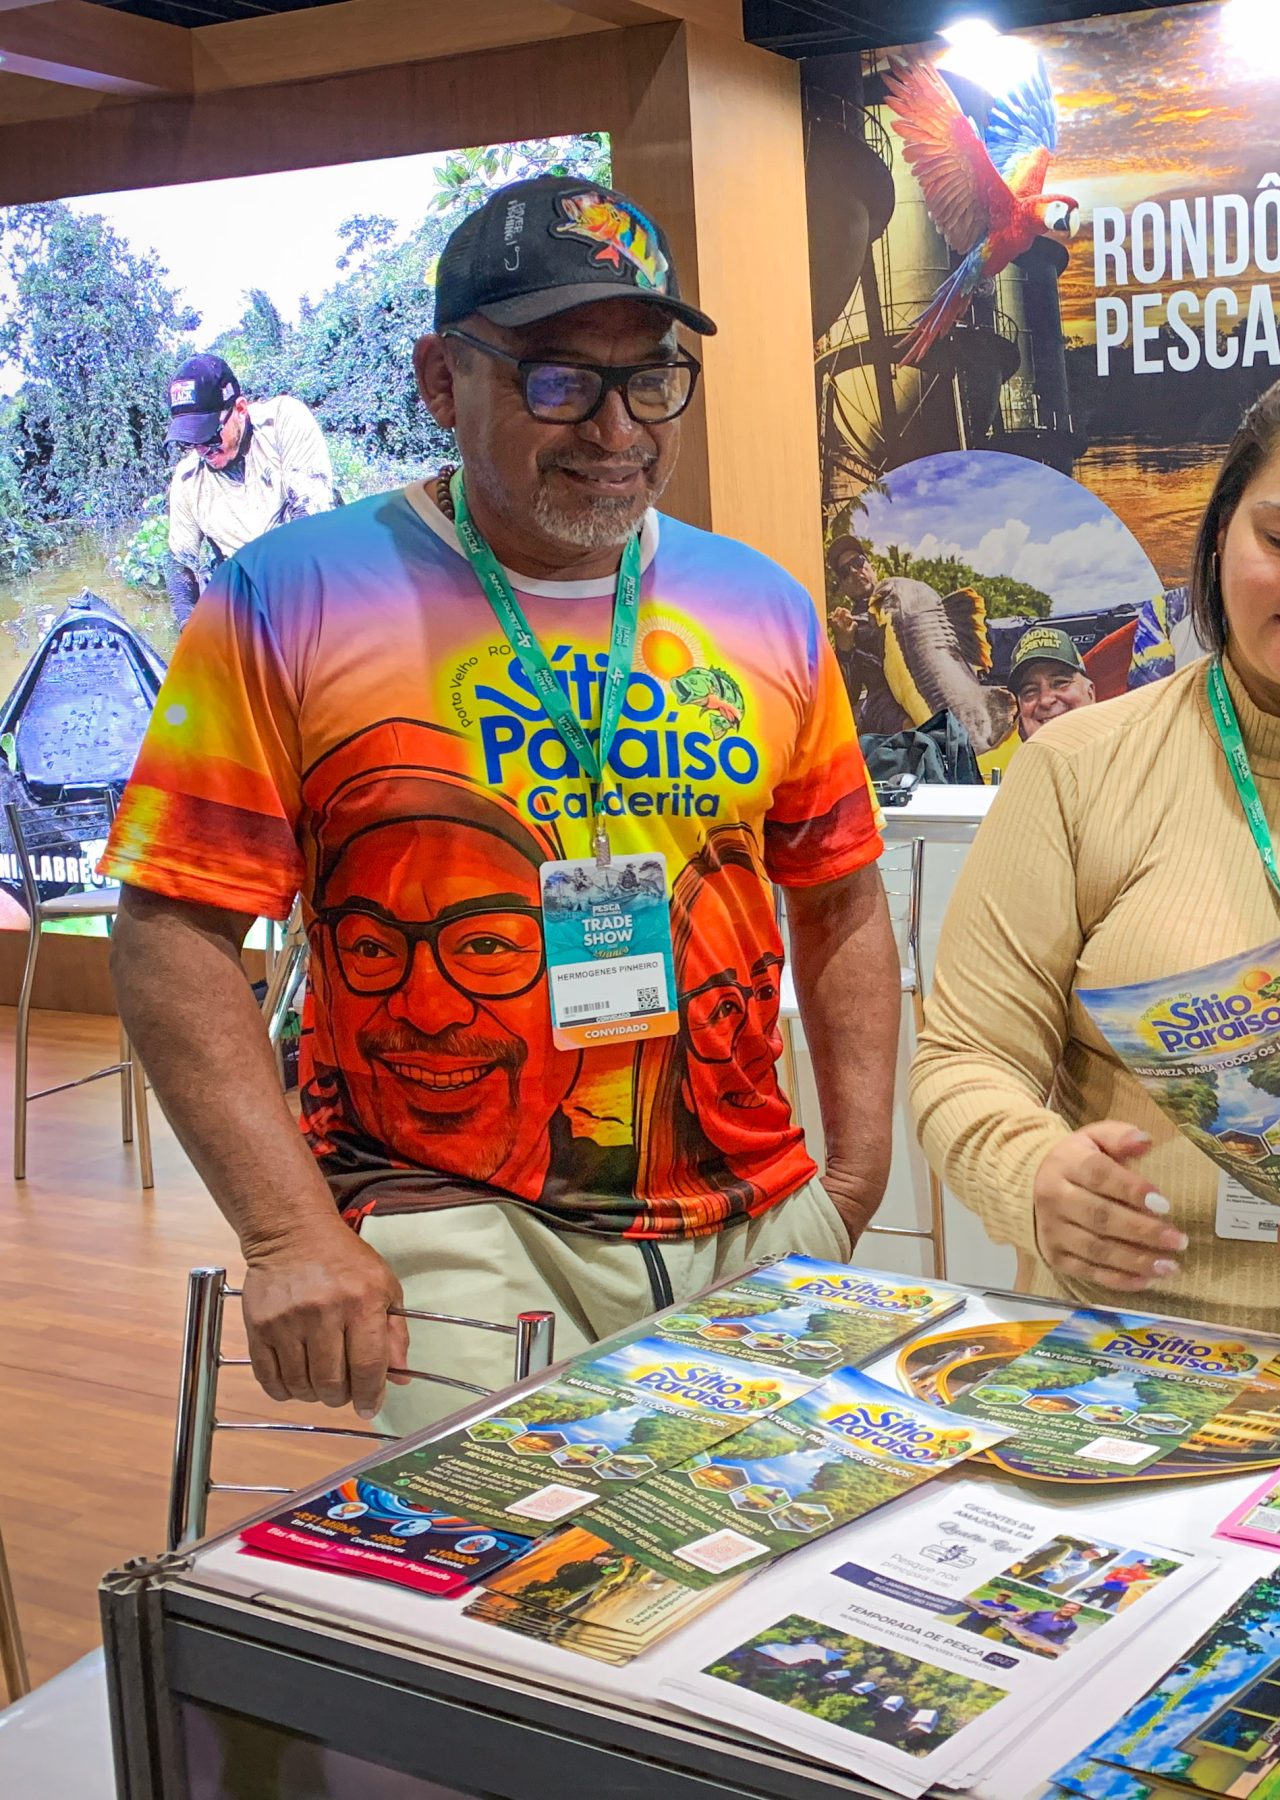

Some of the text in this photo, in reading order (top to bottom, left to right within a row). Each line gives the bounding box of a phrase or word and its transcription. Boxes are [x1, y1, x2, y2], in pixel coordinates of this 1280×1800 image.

[1097, 284, 1280, 376] PESCA
[460, 520, 481, 554] PESCA
[626, 575, 636, 607] PESCA
[450, 645, 511, 727] Porto Velho RO
[556, 714, 583, 750] PESCA
[527, 783, 720, 822] Calderita
[592, 903, 621, 912] PESCA
[581, 914, 633, 932] TRADE
[583, 930, 633, 947] SHOW
[557, 961, 659, 982] HERMOGENES PINHEIRO
[1152, 993, 1252, 1031] Sítio
[584, 1023, 648, 1039] CONVIDADO
[1134, 1066, 1186, 1077] NATUREZA
[1187, 1065, 1216, 1076] PARA
[1219, 1051, 1258, 1070] TODOS
[1258, 1046, 1276, 1059] OS
[732, 1286, 783, 1302] NATUREZA
[799, 1281, 902, 1311] Paraiso
[819, 1274, 895, 1298] Sítio
[1102, 1339, 1223, 1372] Paraiso
[1118, 1333, 1212, 1358] Sítio
[664, 1366, 742, 1394] Sítio
[1034, 1349, 1092, 1366] NATUREZA
[1095, 1360, 1124, 1372] PARA
[1183, 1375, 1228, 1390] LADOS!
[566, 1377, 730, 1429] NATUREZA PARA TODOS LADOS!
[636, 1372, 742, 1411] Paraiso
[827, 1413, 930, 1461] Paraiso
[857, 1408, 934, 1443] Sítio
[768, 1413, 916, 1478] ATUREZA PARA TODOS LADOS!
[665, 1504, 717, 1534] ACOLHEDOR
[689, 1500, 710, 1512] COM
[720, 1507, 766, 1532] CORRERIA
[963, 1502, 1019, 1527] GIGANTES
[290, 1518, 337, 1538] Em Prêmios
[633, 1525, 661, 1543] NORTE
[953, 1509, 1014, 1536] AMAZÔNIA
[267, 1527, 452, 1581] Elas Pescando Mulheres Pescando
[889, 1552, 938, 1576] Pesque
[940, 1570, 961, 1582] nos
[634, 1607, 660, 1626] Pesca
[636, 1588, 678, 1617] verdadeiro
[847, 1604, 985, 1658] TEMPORADA DE PESCA
